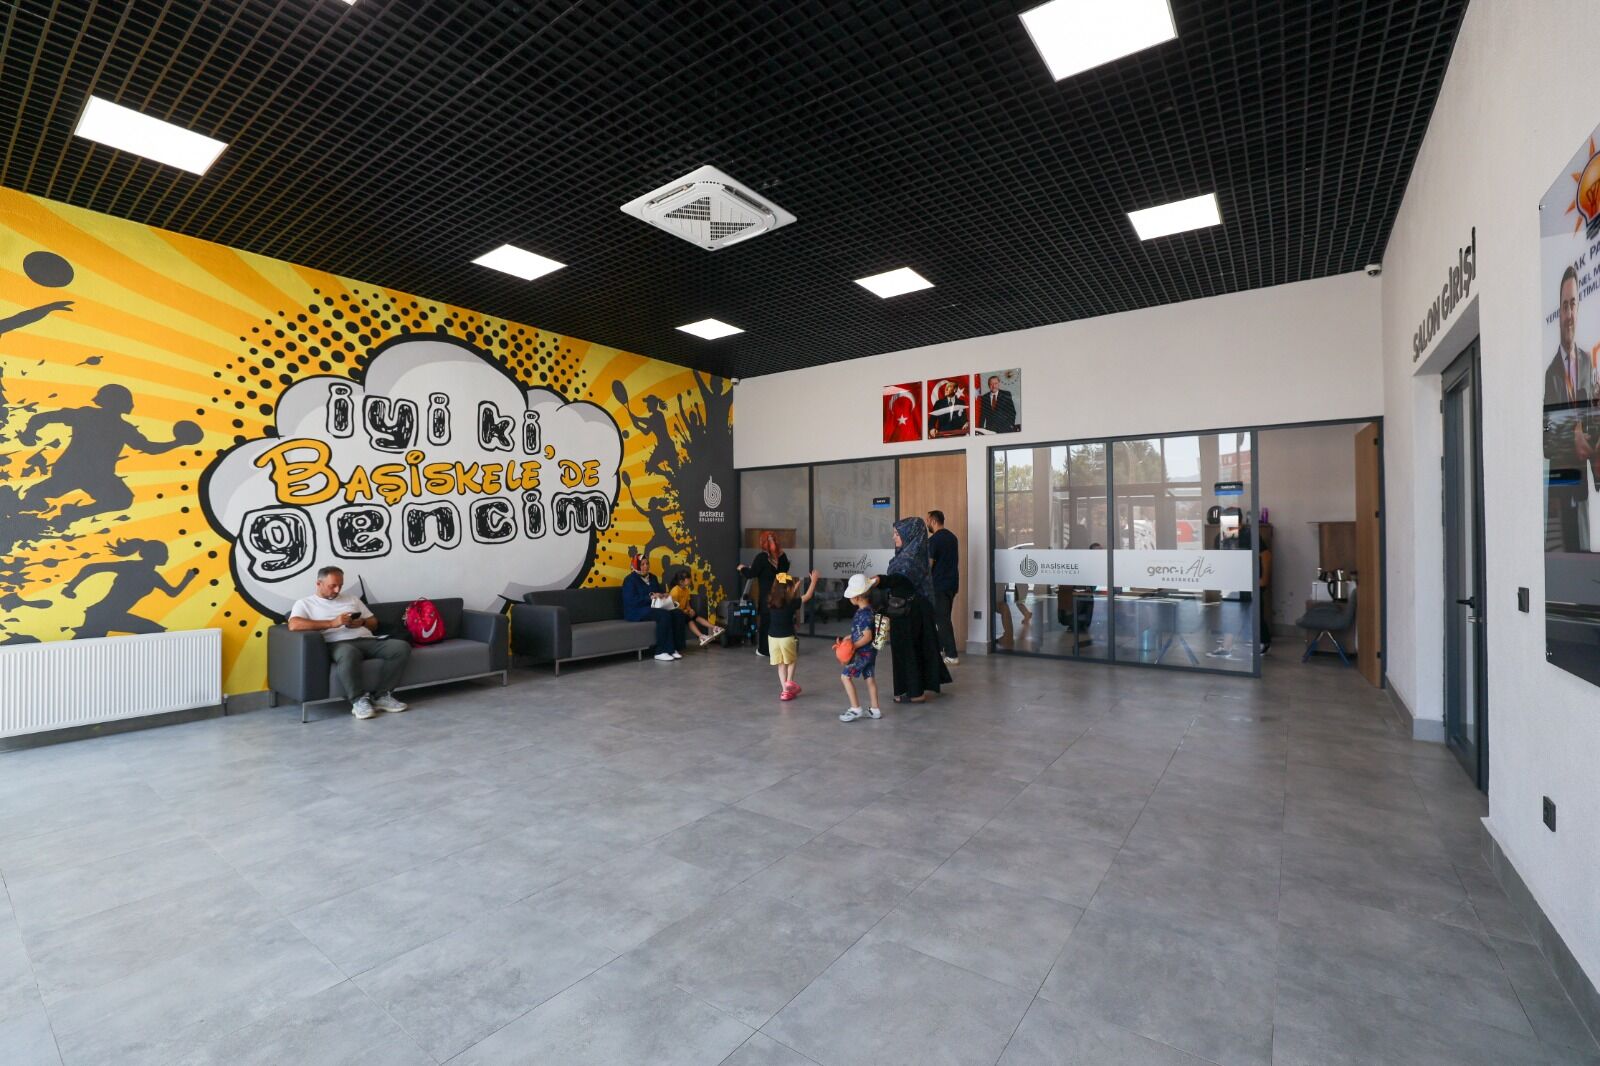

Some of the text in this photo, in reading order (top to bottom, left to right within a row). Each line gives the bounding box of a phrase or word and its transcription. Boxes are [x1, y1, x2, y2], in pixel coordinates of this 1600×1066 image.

[1413, 295, 1440, 363] SALON
[326, 382, 541, 455] iyi ki
[238, 490, 611, 583] gencim
